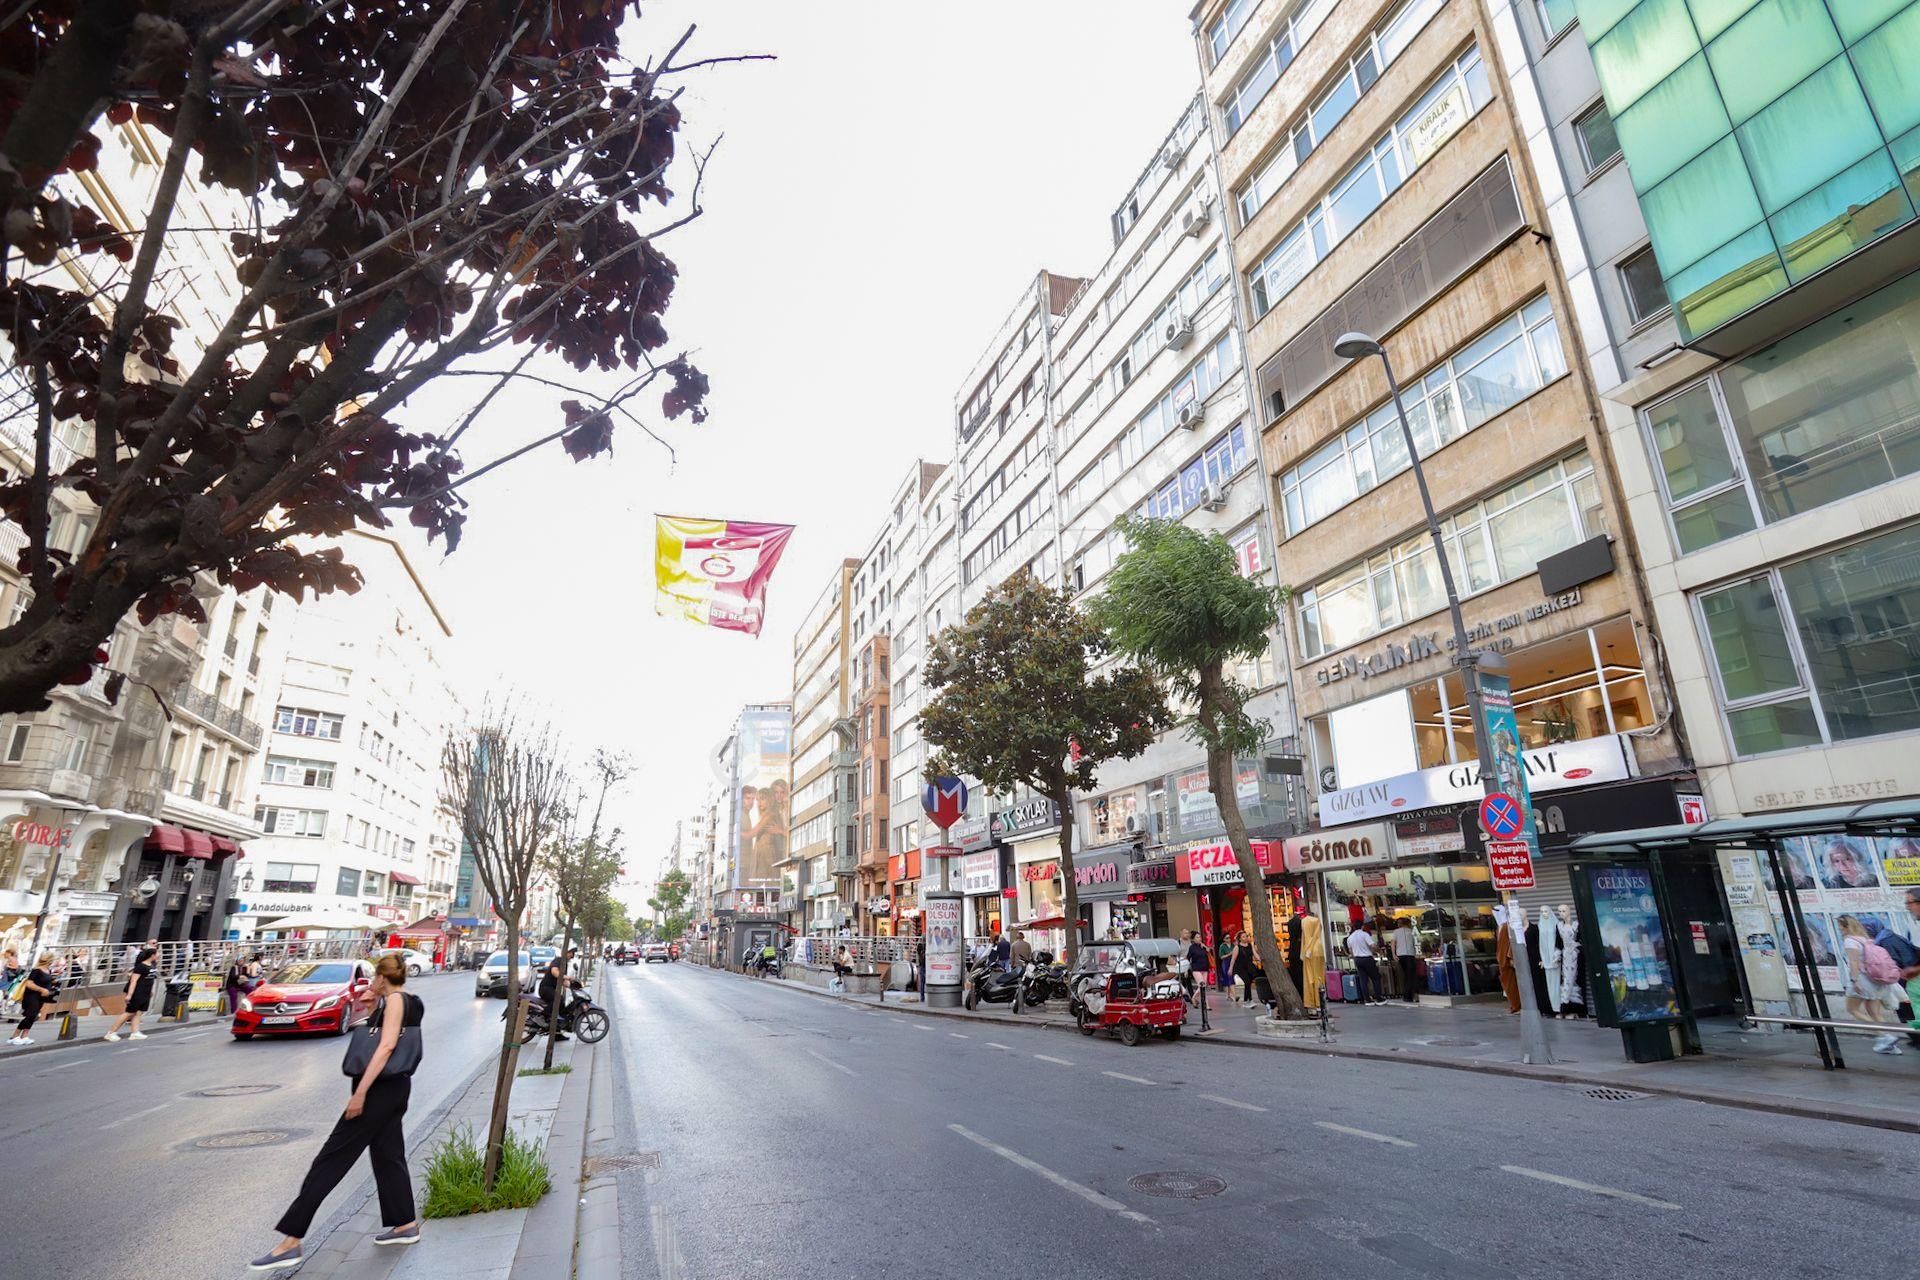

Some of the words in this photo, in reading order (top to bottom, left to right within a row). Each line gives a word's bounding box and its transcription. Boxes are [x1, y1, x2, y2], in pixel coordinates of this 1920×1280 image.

[1015, 799, 1048, 823] SKYLAR
[1299, 837, 1373, 865] sörmen
[1597, 876, 1647, 890] CELENES
[249, 902, 313, 913] Anadolubank
